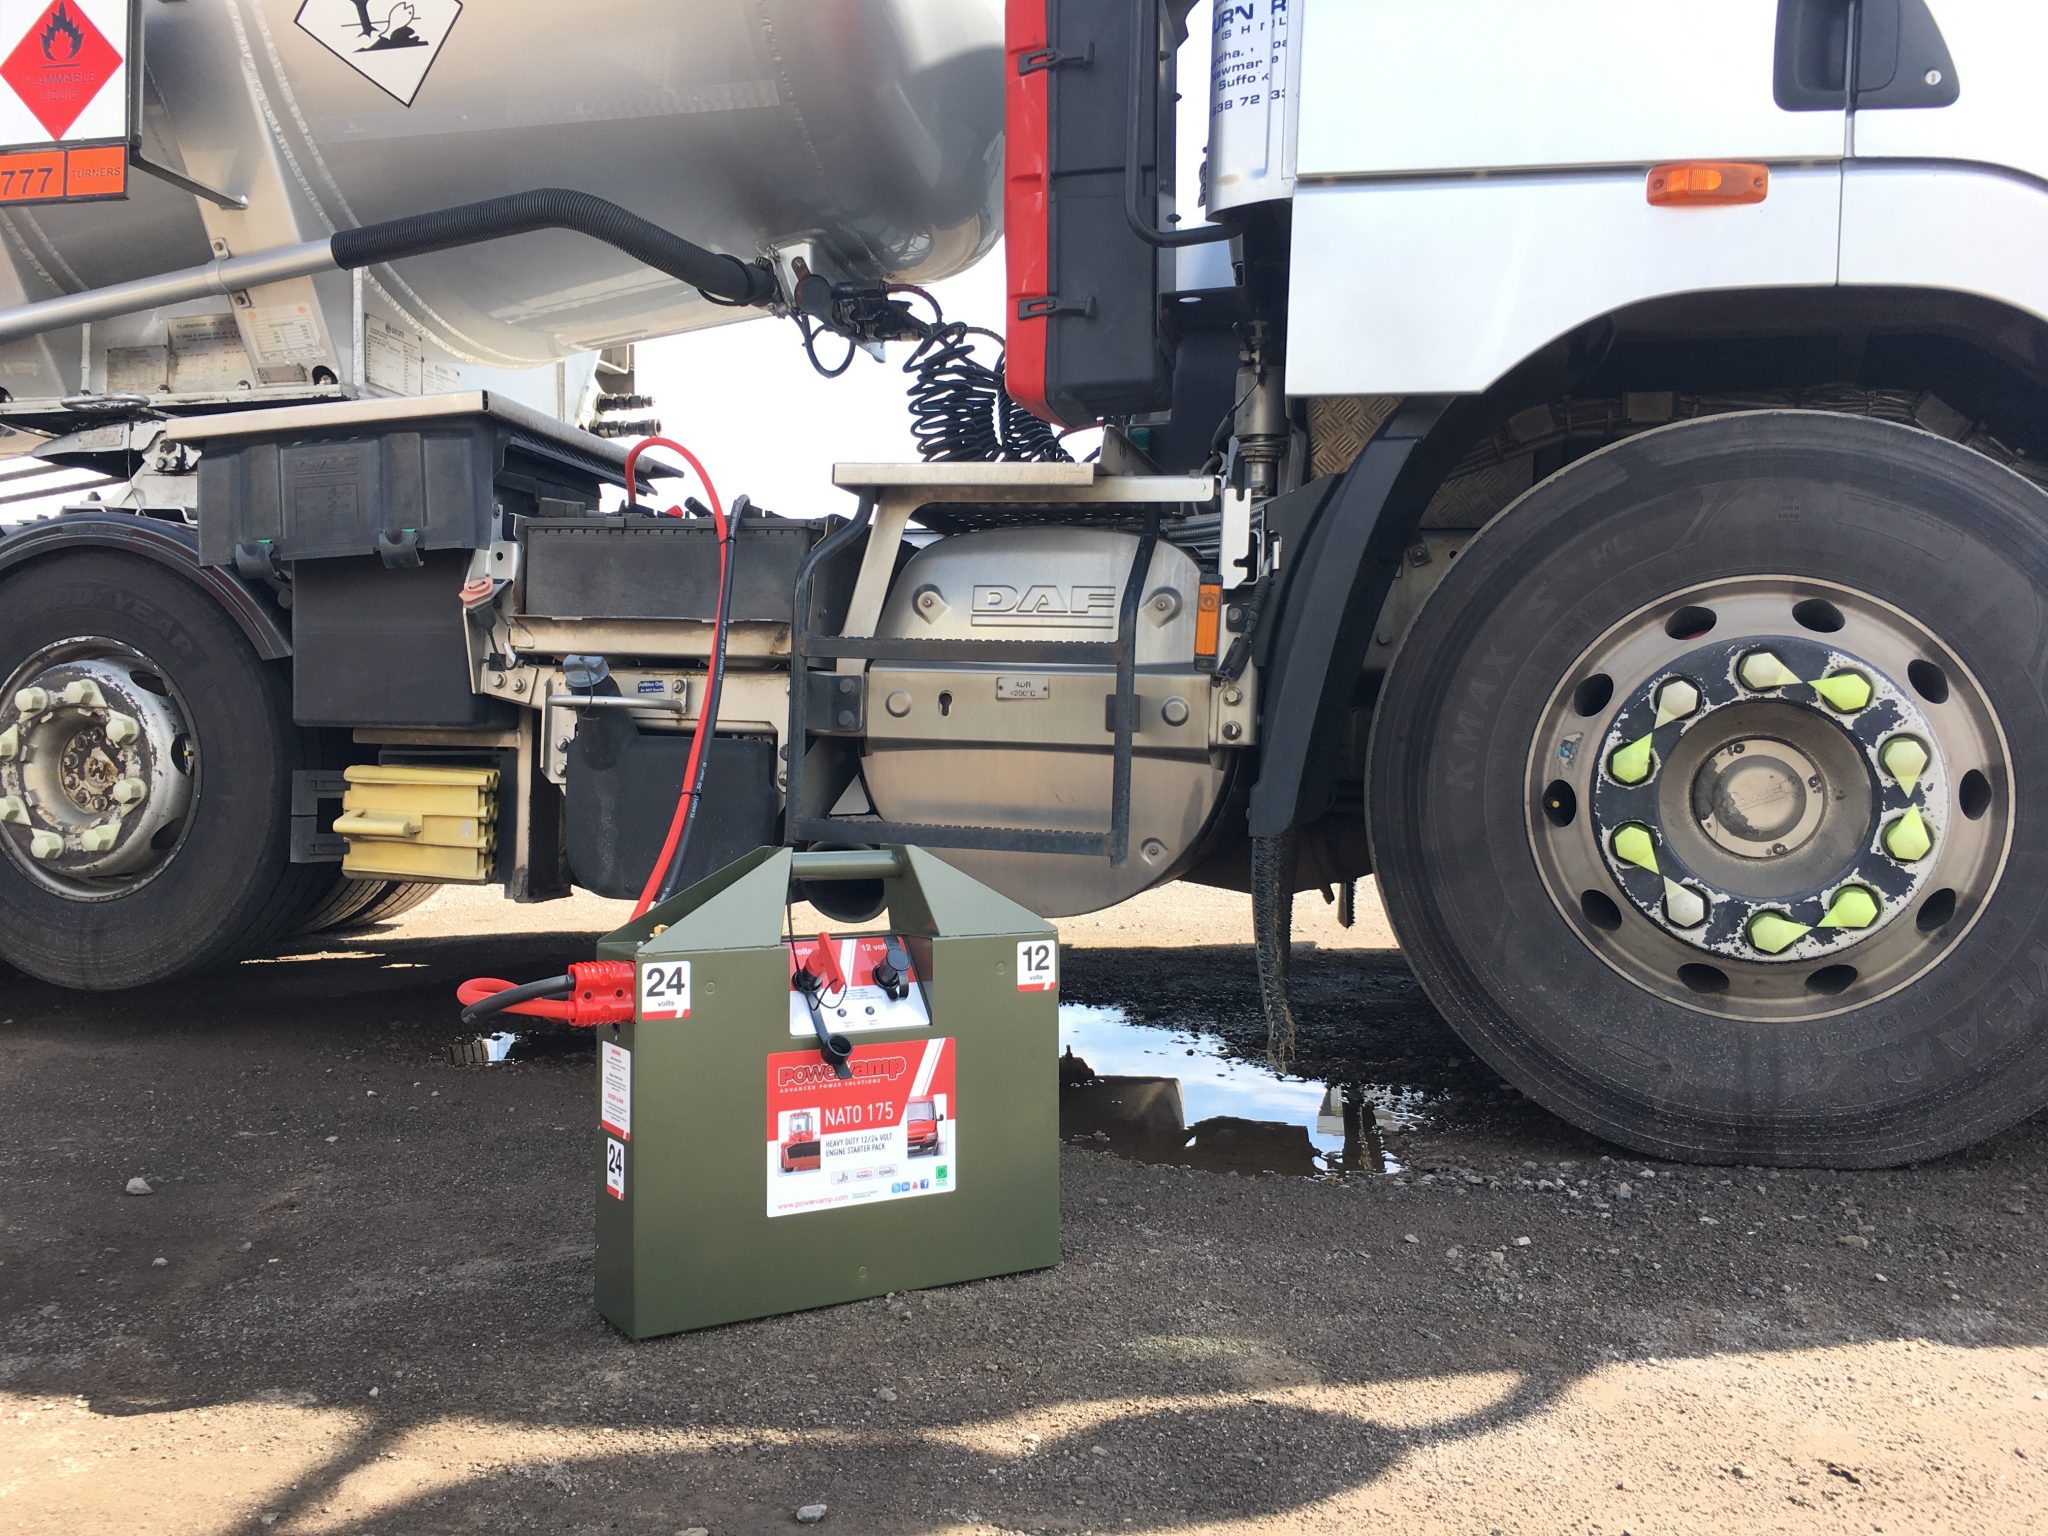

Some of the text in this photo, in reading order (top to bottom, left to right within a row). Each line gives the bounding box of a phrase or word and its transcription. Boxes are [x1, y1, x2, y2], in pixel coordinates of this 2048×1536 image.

[72, 167, 121, 179] TURNERS
[971, 584, 1116, 614] DAF
[1022, 945, 1050, 971] 12
[646, 967, 685, 997] 24
[780, 1078, 881, 1093] ADVANCED POWER SOLUTIONS
[825, 1101, 894, 1126] NATO 175
[826, 1133, 893, 1147] HEAVY DUTY 12/24 VOLT
[826, 1143, 886, 1157] ENGINE STARTER PACK
[609, 1144, 622, 1177] 24
